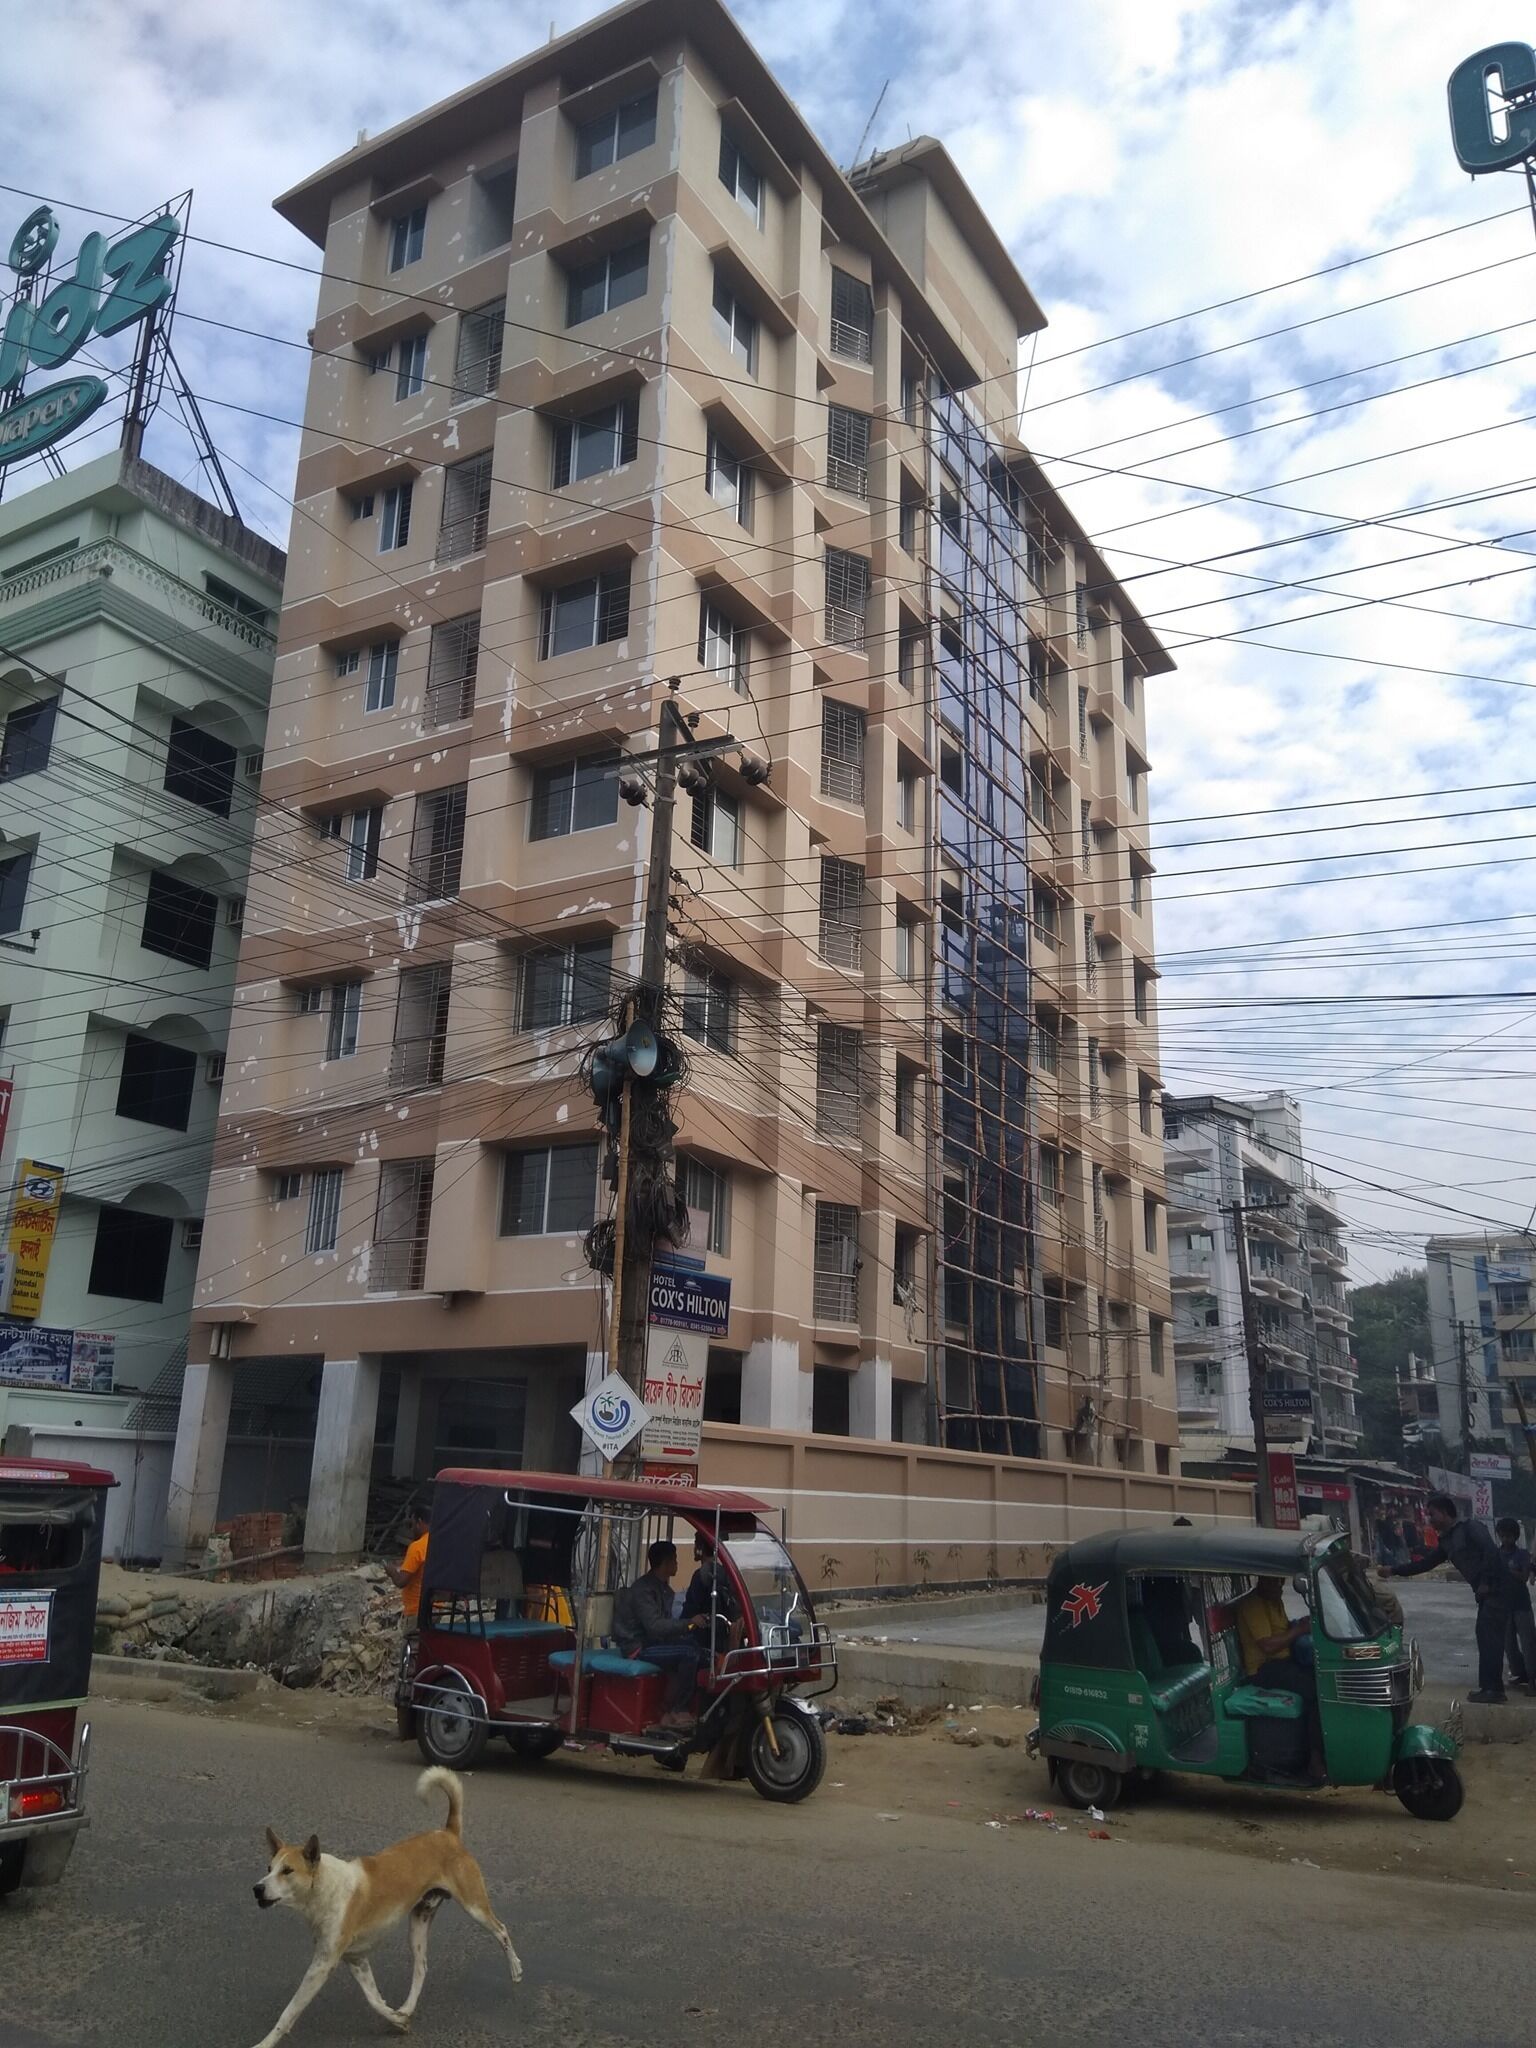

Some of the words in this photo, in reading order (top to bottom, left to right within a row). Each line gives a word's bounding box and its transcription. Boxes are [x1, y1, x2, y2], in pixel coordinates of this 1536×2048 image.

[0, 204, 181, 391] idz
[0, 386, 82, 446] iapers
[651, 1287, 684, 1311] COX'S
[686, 1294, 727, 1319] HILTON
[653, 1274, 676, 1288] HOTEL
